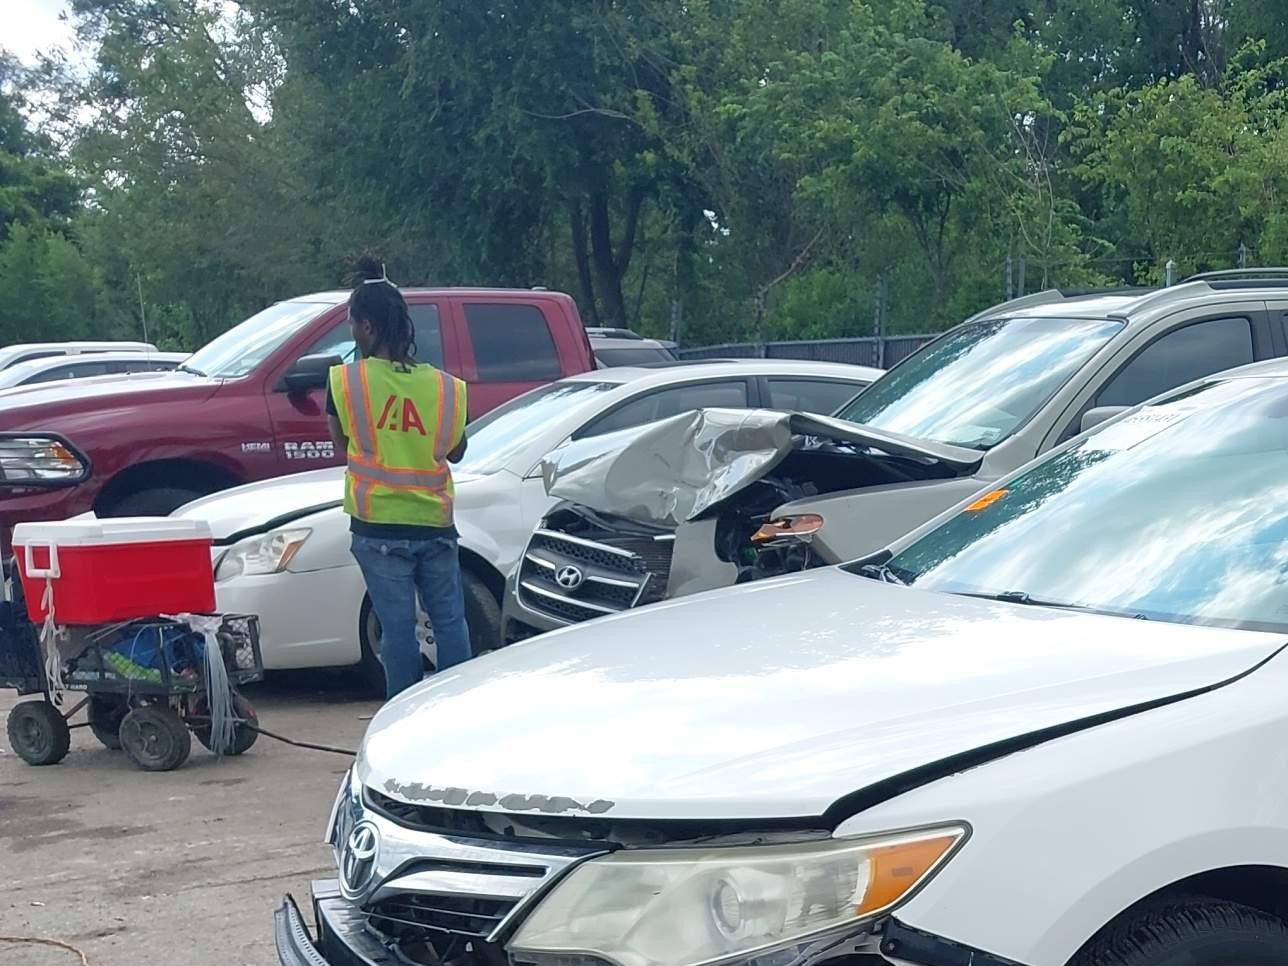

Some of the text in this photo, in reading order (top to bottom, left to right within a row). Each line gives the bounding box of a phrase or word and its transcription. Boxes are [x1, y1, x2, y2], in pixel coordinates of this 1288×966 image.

[241, 442, 271, 452] HEMI
[284, 441, 334, 450] RAM
[285, 450, 335, 459] 1500
